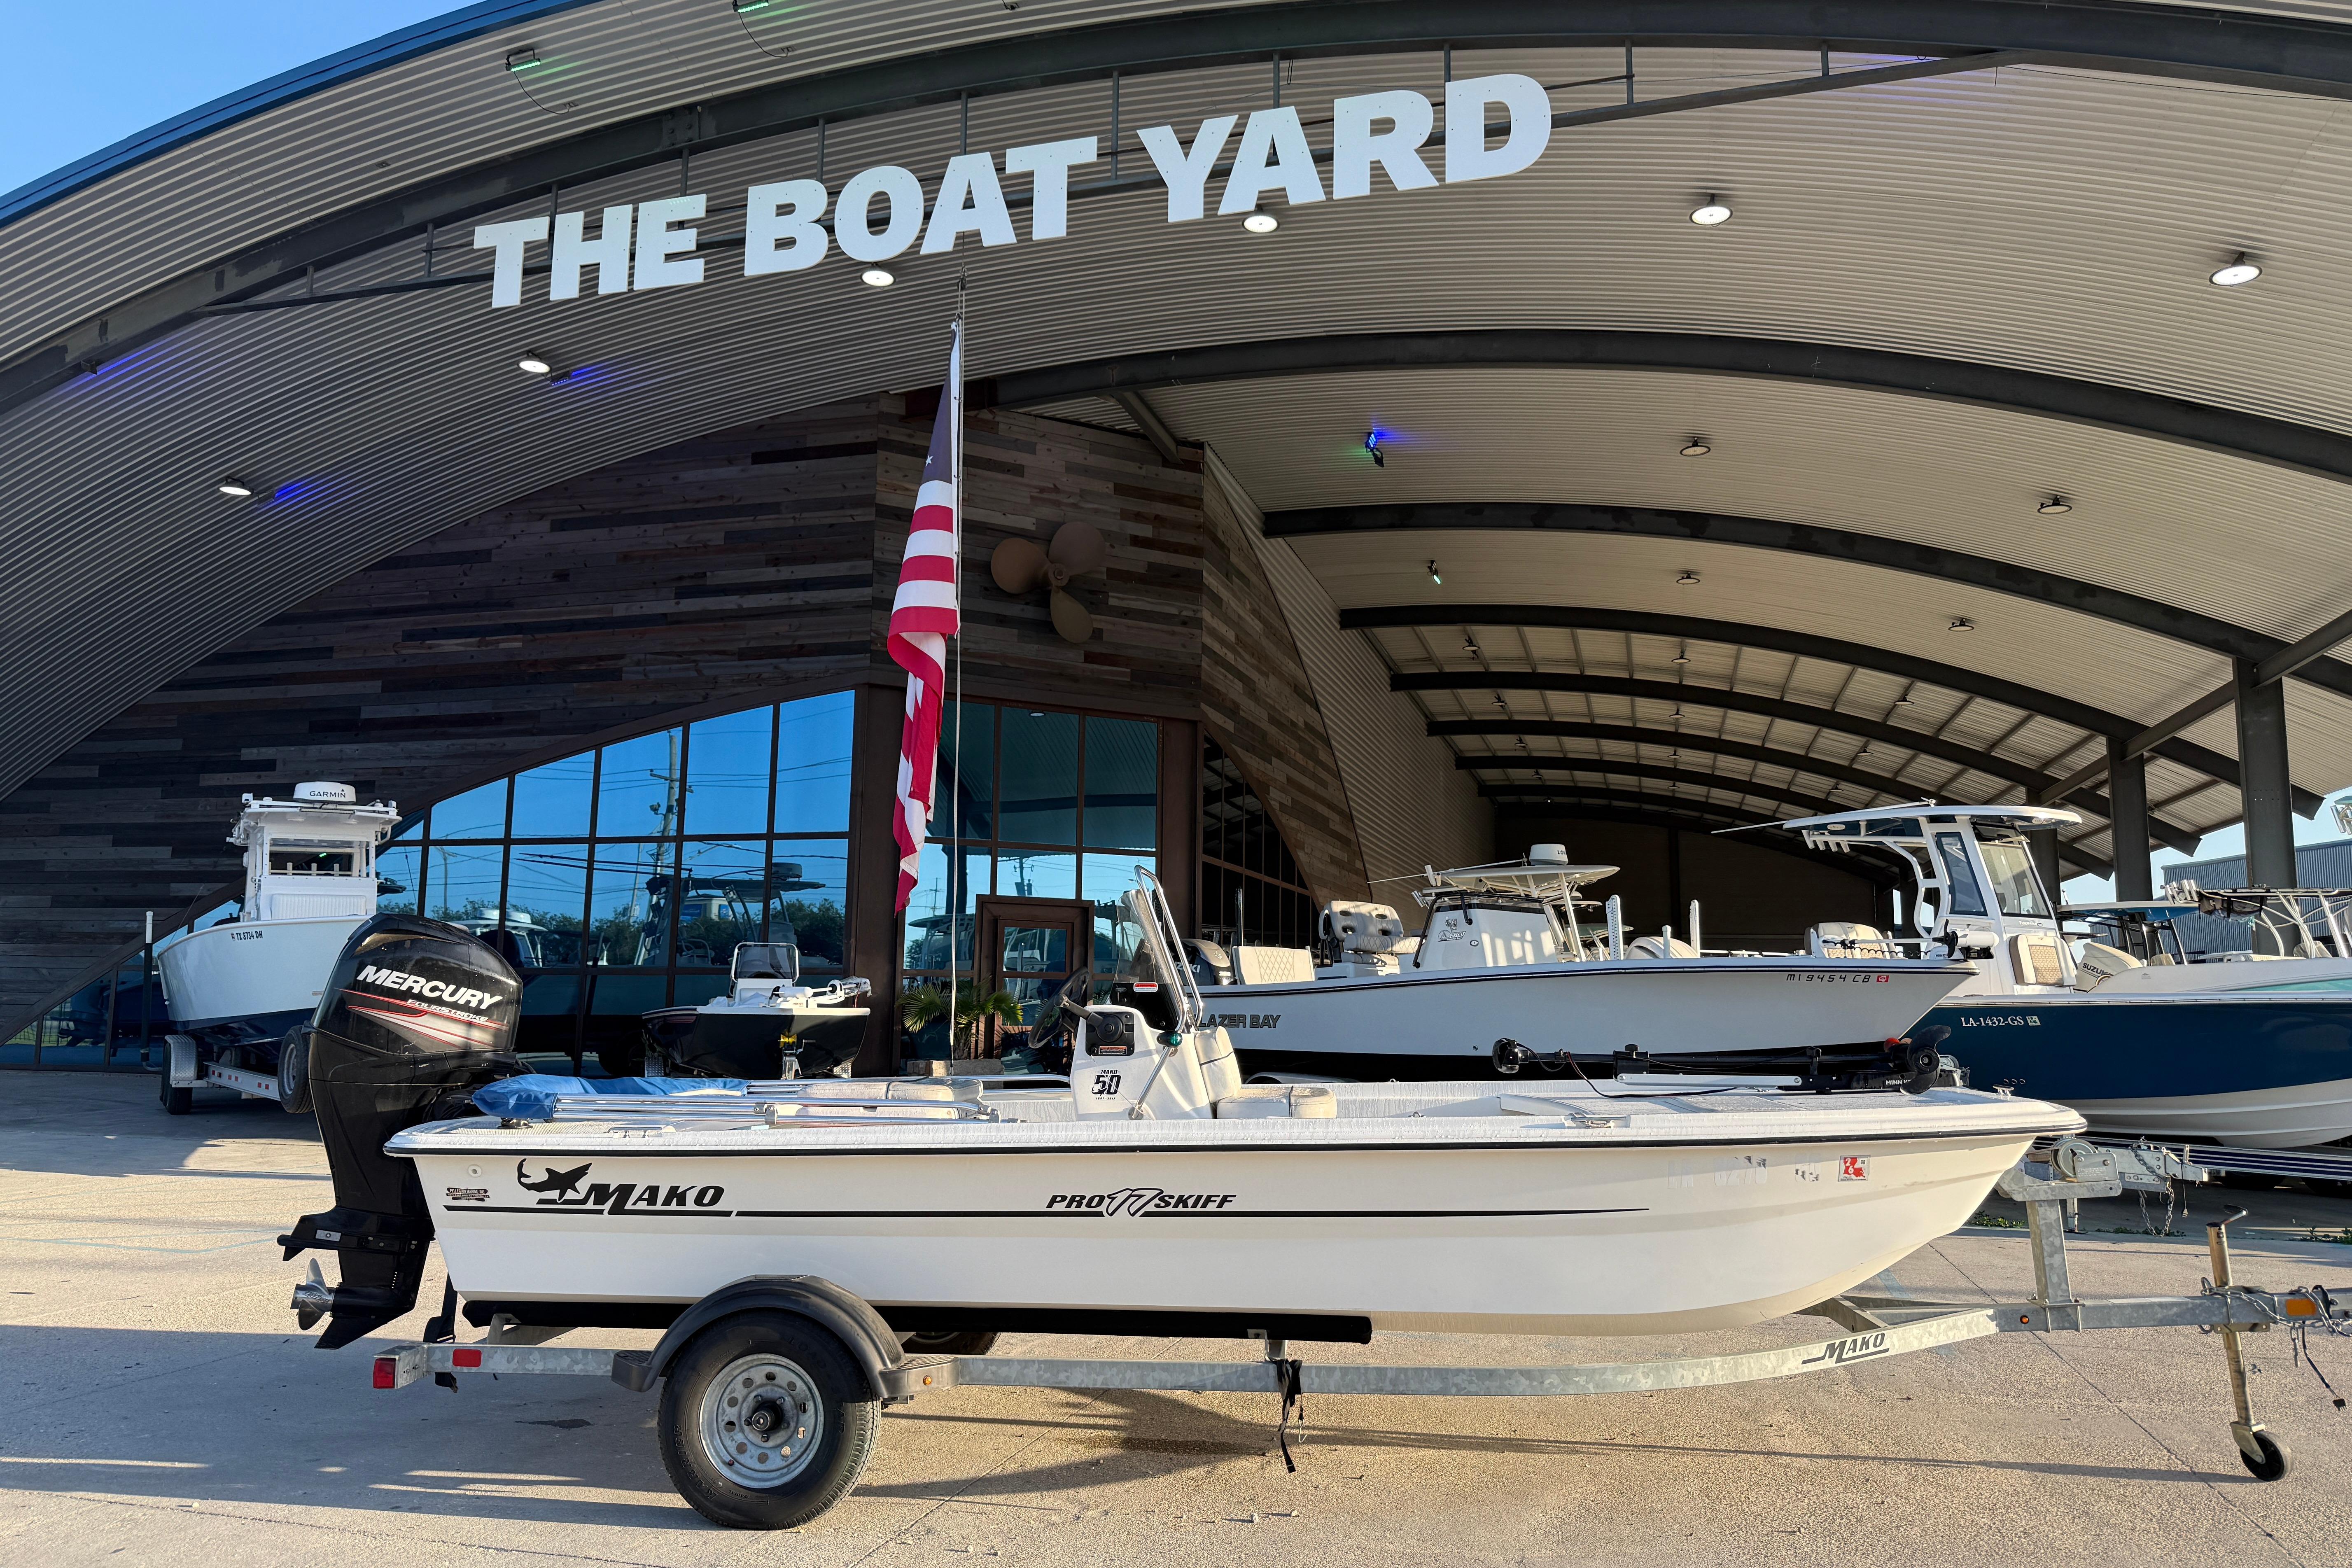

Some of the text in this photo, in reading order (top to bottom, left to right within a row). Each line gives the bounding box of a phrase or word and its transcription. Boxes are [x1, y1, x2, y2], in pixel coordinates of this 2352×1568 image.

[474, 73, 1552, 308] THE BOAT YARD
[236, 932, 243, 940] TX
[243, 931, 254, 940] 8734
[254, 930, 263, 939] DH
[1806, 974, 1847, 982] 9454
[1852, 974, 1871, 983] CB
[2082, 962, 2110, 976] SUZUK
[356, 965, 503, 1010] MERCURY
[1195, 1014, 1281, 1029] LAZER BAY
[1960, 1016, 2024, 1026] LA-1432-GS
[1093, 1074, 1121, 1095] 50
[581, 1183, 726, 1216] MAKO
[1045, 1188, 1237, 1217] PRO 17 SKIFF
[1822, 1332, 1886, 1364] MAKO
[674, 1424, 718, 1500] KARRIER
